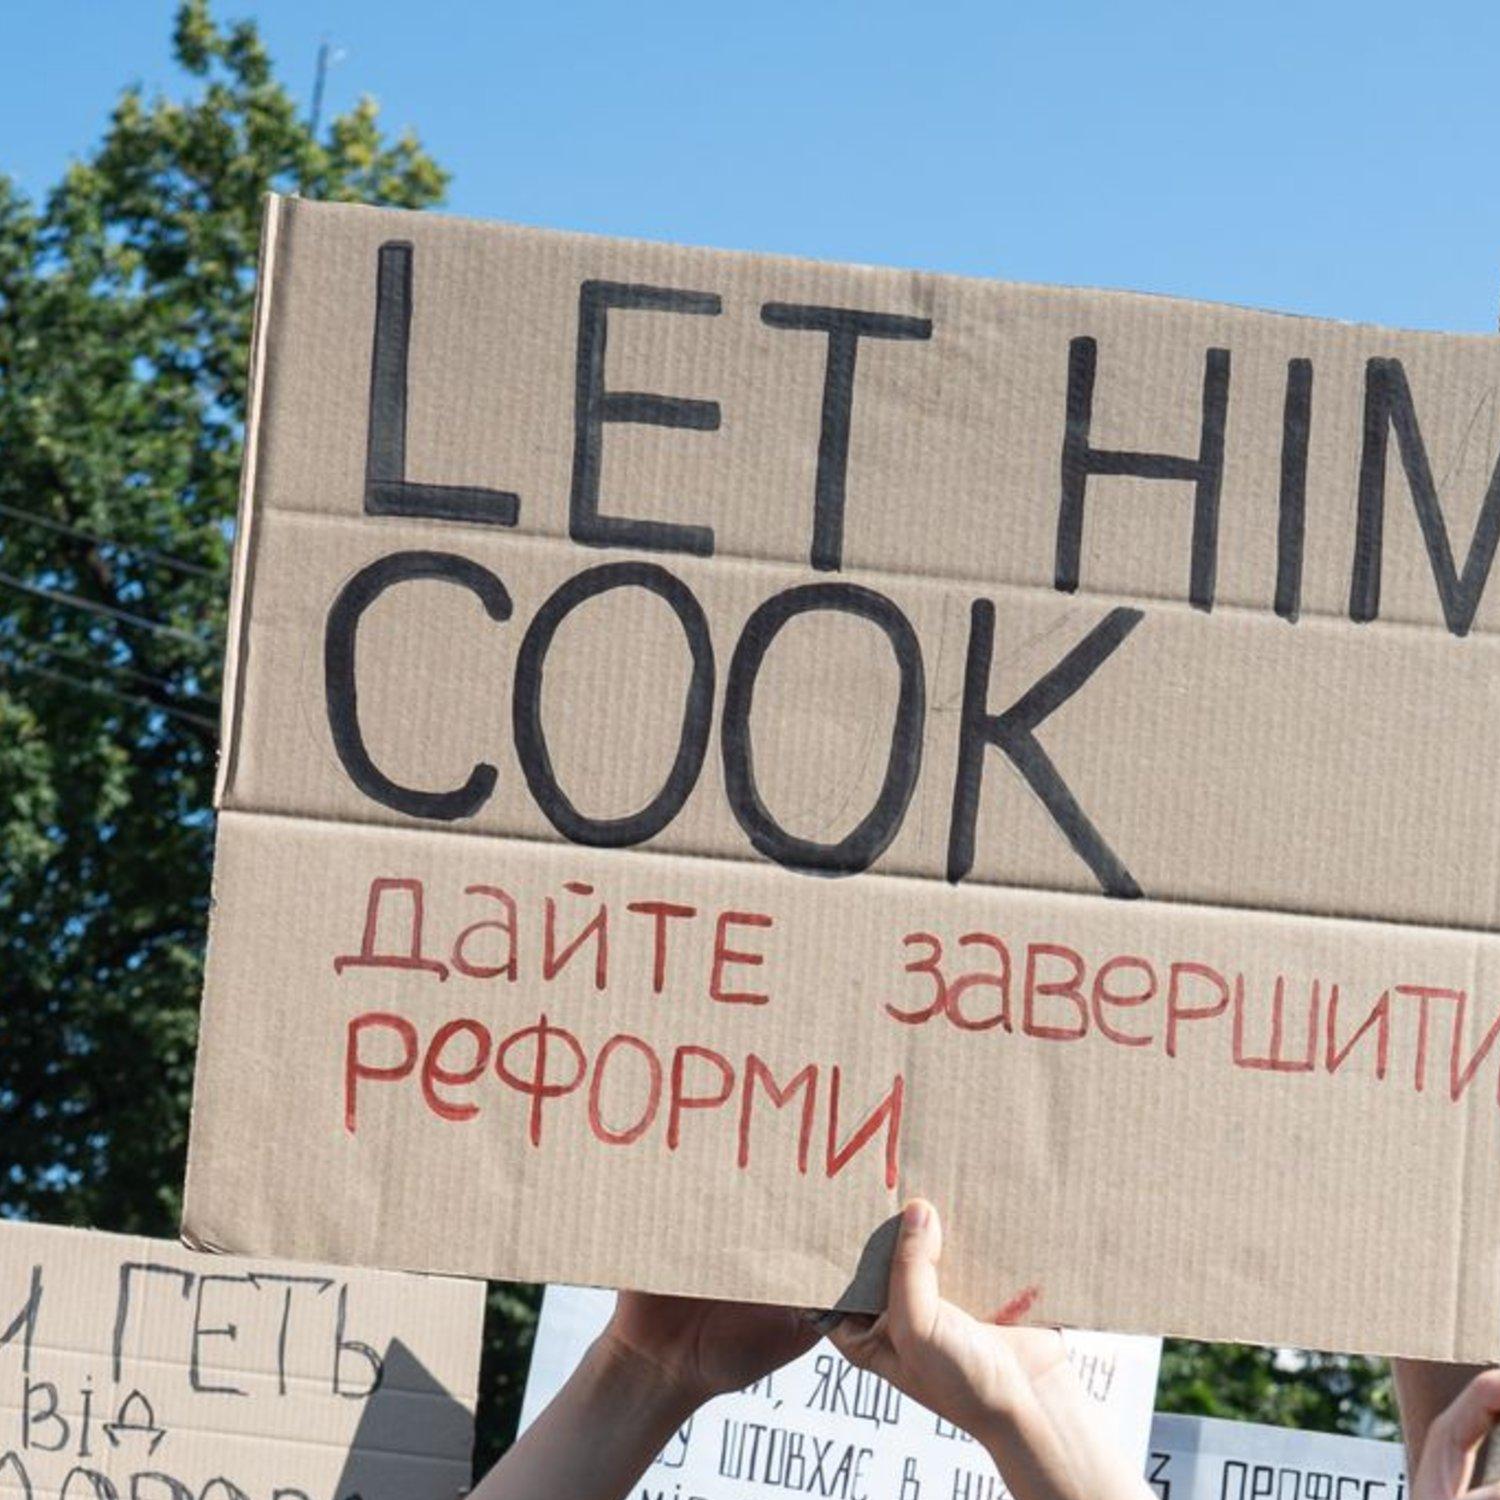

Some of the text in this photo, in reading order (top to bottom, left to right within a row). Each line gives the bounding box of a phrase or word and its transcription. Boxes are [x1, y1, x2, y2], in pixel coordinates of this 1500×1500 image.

[364, 240, 932, 571] LET
[325, 550, 1144, 898] COOK
[22, 1375, 167, 1458] ВІД
[113, 1262, 384, 1399] ГЕТЬ
